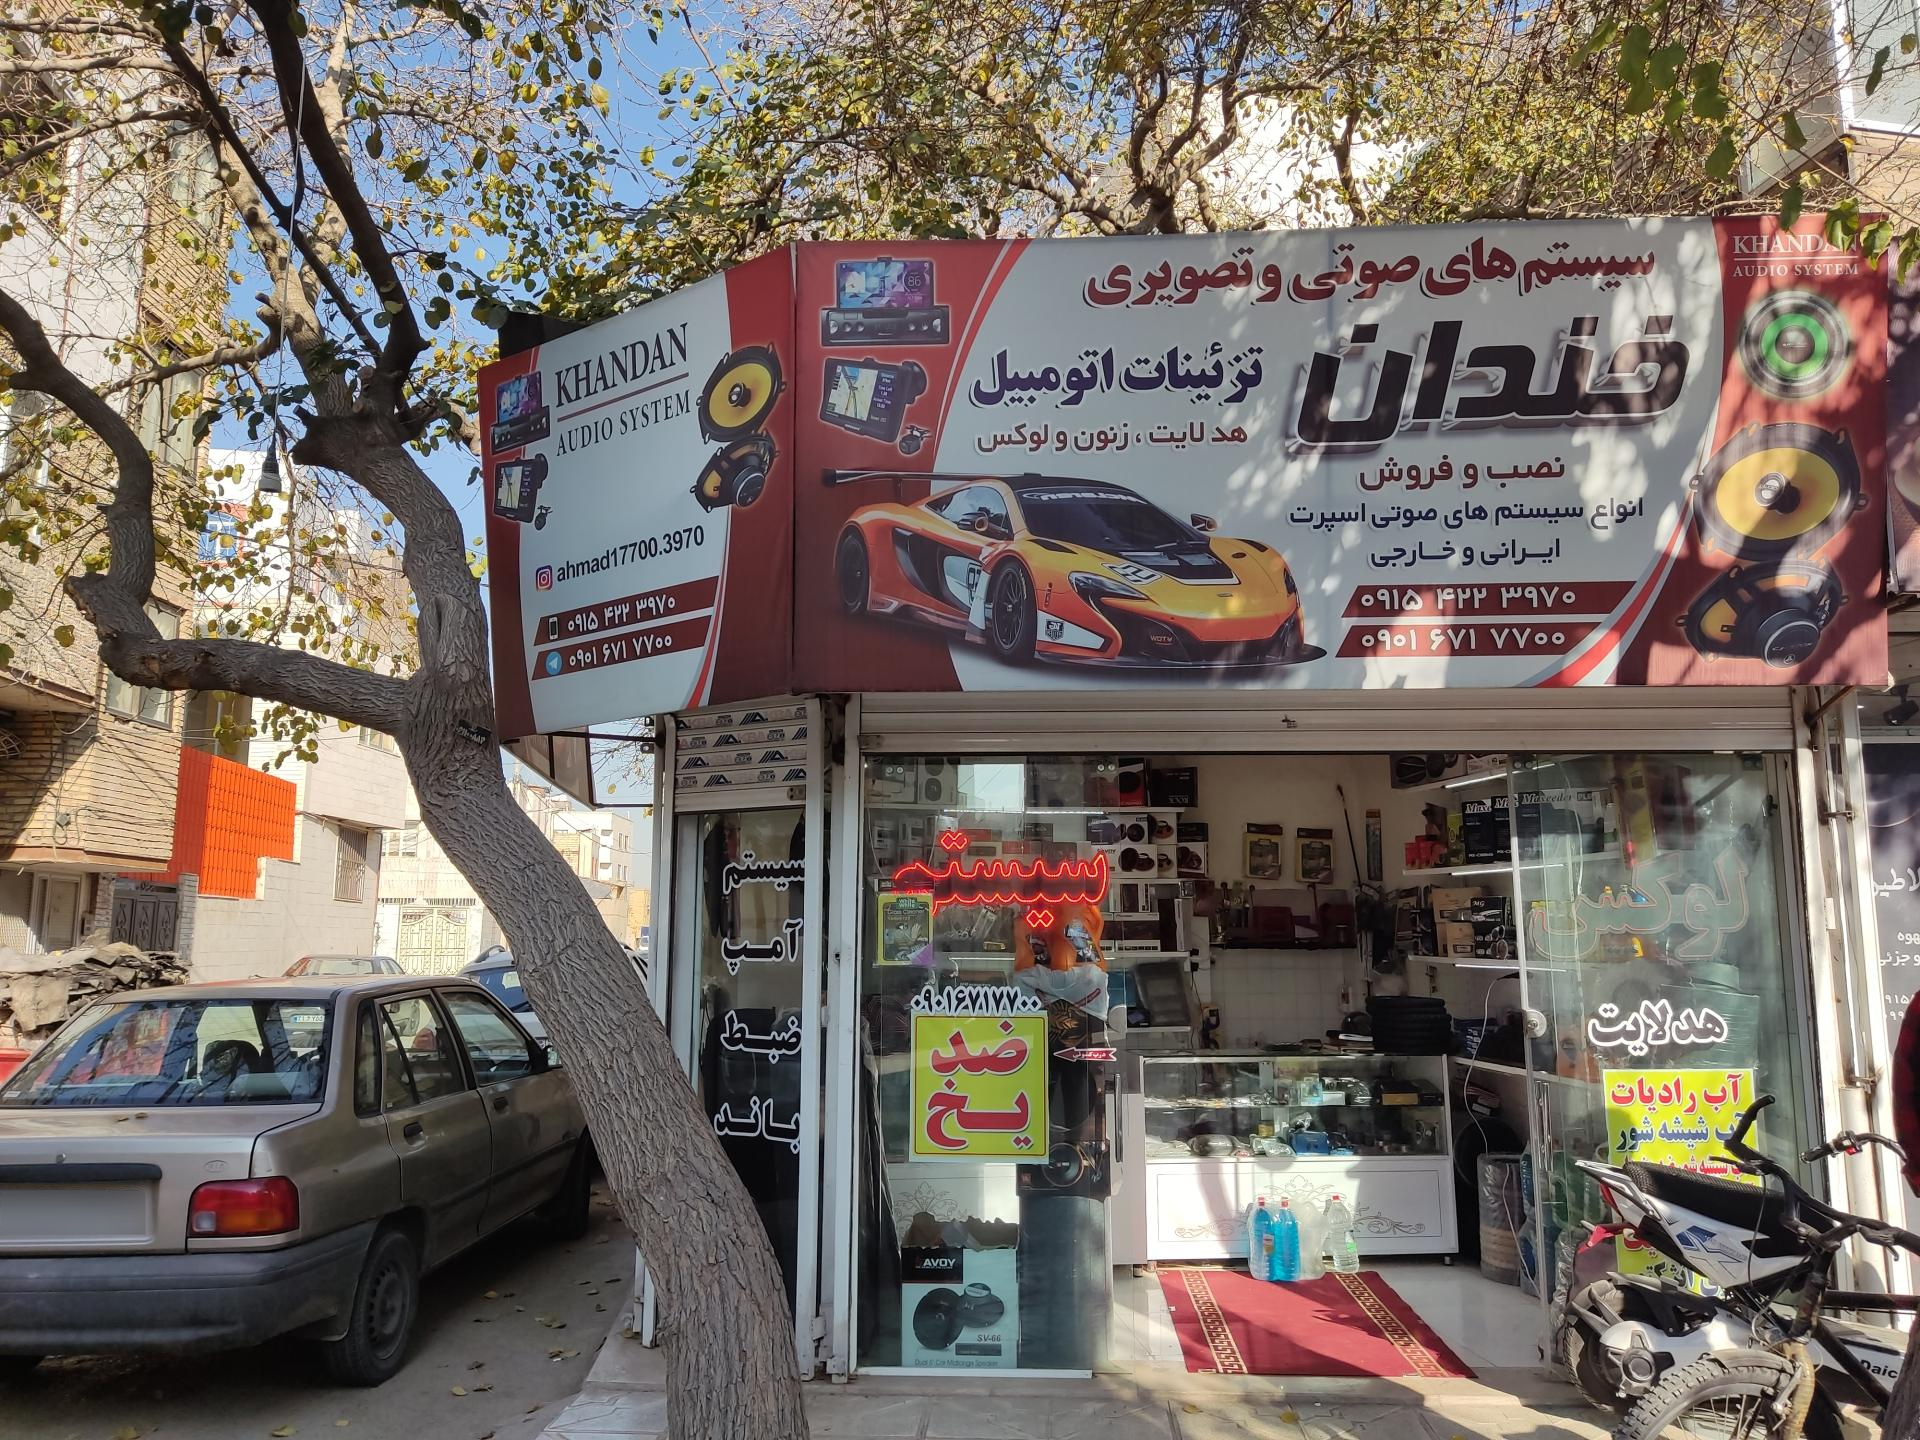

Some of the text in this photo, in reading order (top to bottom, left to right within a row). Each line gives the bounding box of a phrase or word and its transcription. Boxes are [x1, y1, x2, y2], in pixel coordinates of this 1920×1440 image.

[1290, 243, 1420, 301] صوتی
[1424, 236, 1517, 296] های
[1522, 241, 1655, 294] سیستم
[1733, 263, 1859, 277] AUDIO SYSTEM
[554, 322, 688, 408] KHANDAN
[972, 341, 1264, 406] تزئینات اتومبیل
[1295, 314, 1691, 446] خندان
[556, 389, 691, 457] AUDIO SYSTEM
[977, 423, 1049, 452] لوکس
[1073, 422, 1129, 451] زنون
[1359, 454, 1565, 491] نصب و فروش
[1289, 497, 1643, 532] انواع سیستم های صوتی اسپرت
[556, 525, 705, 582] ahmad17700.3970
[1371, 538, 1560, 567] ایرانی و خارجی
[567, 594, 676, 632] ۰۹۱۵ ۴۲۲ ۳۹۷۰
[1361, 586, 1576, 611] ۰۹۱۵ ۴۲۲ ۳۹۷۰
[569, 634, 673, 667] ۰۹۰۱ ۶۷۱ ۷۷۰۰
[1361, 627, 1565, 651] ۰۹۰۱ ۶۷۱ ۷۷۰۰
[722, 849, 806, 895] سیستم
[895, 832, 1108, 927] سیستم
[1527, 845, 1751, 961] لوکس
[721, 918, 804, 976] آمپ
[911, 984, 1042, 1017] ۰۹۰۱۶۷۱۷۷۰۰
[720, 1009, 802, 1064] ضبط
[929, 1018, 1030, 1077] ضد
[926, 1079, 1032, 1150] یخ
[1611, 1072, 1743, 1114] آب رادیات
[714, 1095, 801, 1154] باند
[1616, 1116, 1654, 1151] شور
[1658, 1116, 1709, 1149] شیشه
[977, 1334, 1001, 1342] SV-66
